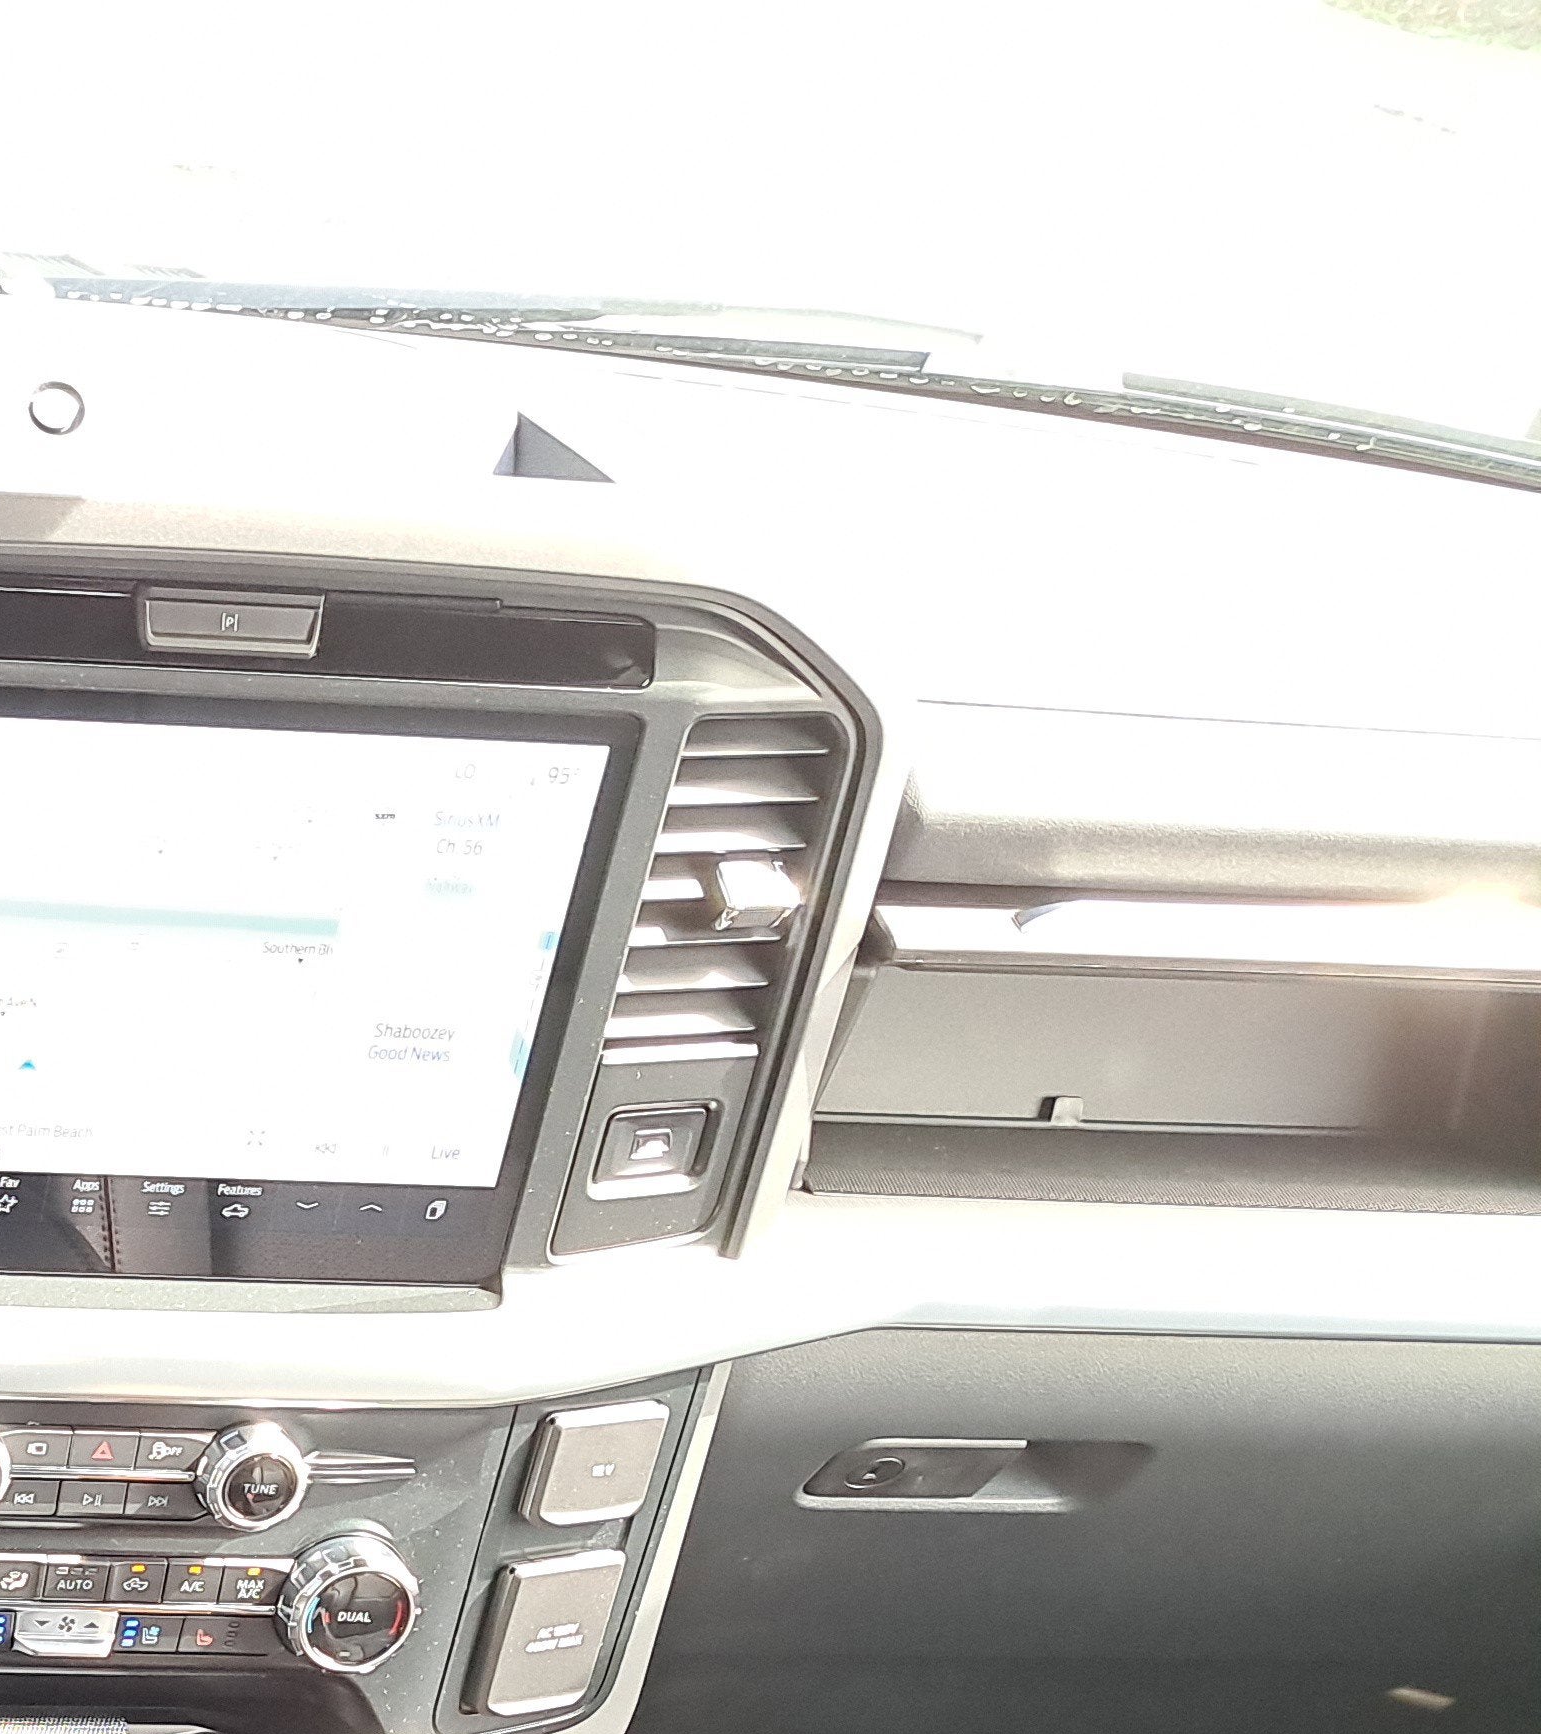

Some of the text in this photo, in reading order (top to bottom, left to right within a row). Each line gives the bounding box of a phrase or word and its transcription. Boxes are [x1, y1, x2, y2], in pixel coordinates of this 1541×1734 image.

[262, 941, 316, 955] Southern
[373, 1022, 457, 1042] Shaboozey
[367, 1045, 451, 1062] Good News
[18, 1124, 51, 1137] Palm
[54, 1125, 93, 1138] Beach
[430, 1145, 461, 1160] Live
[0, 1176, 21, 1188] Fav
[73, 1179, 100, 1192] Apps
[141, 1181, 185, 1195] Settings
[217, 1184, 263, 1197] Features
[243, 1483, 278, 1496] TUNE
[56, 1578, 94, 1592] AUTO
[179, 1580, 206, 1593] A/C
[236, 1579, 265, 1591] MAX
[237, 1589, 262, 1600] A/C
[337, 1611, 372, 1624] DUAL
